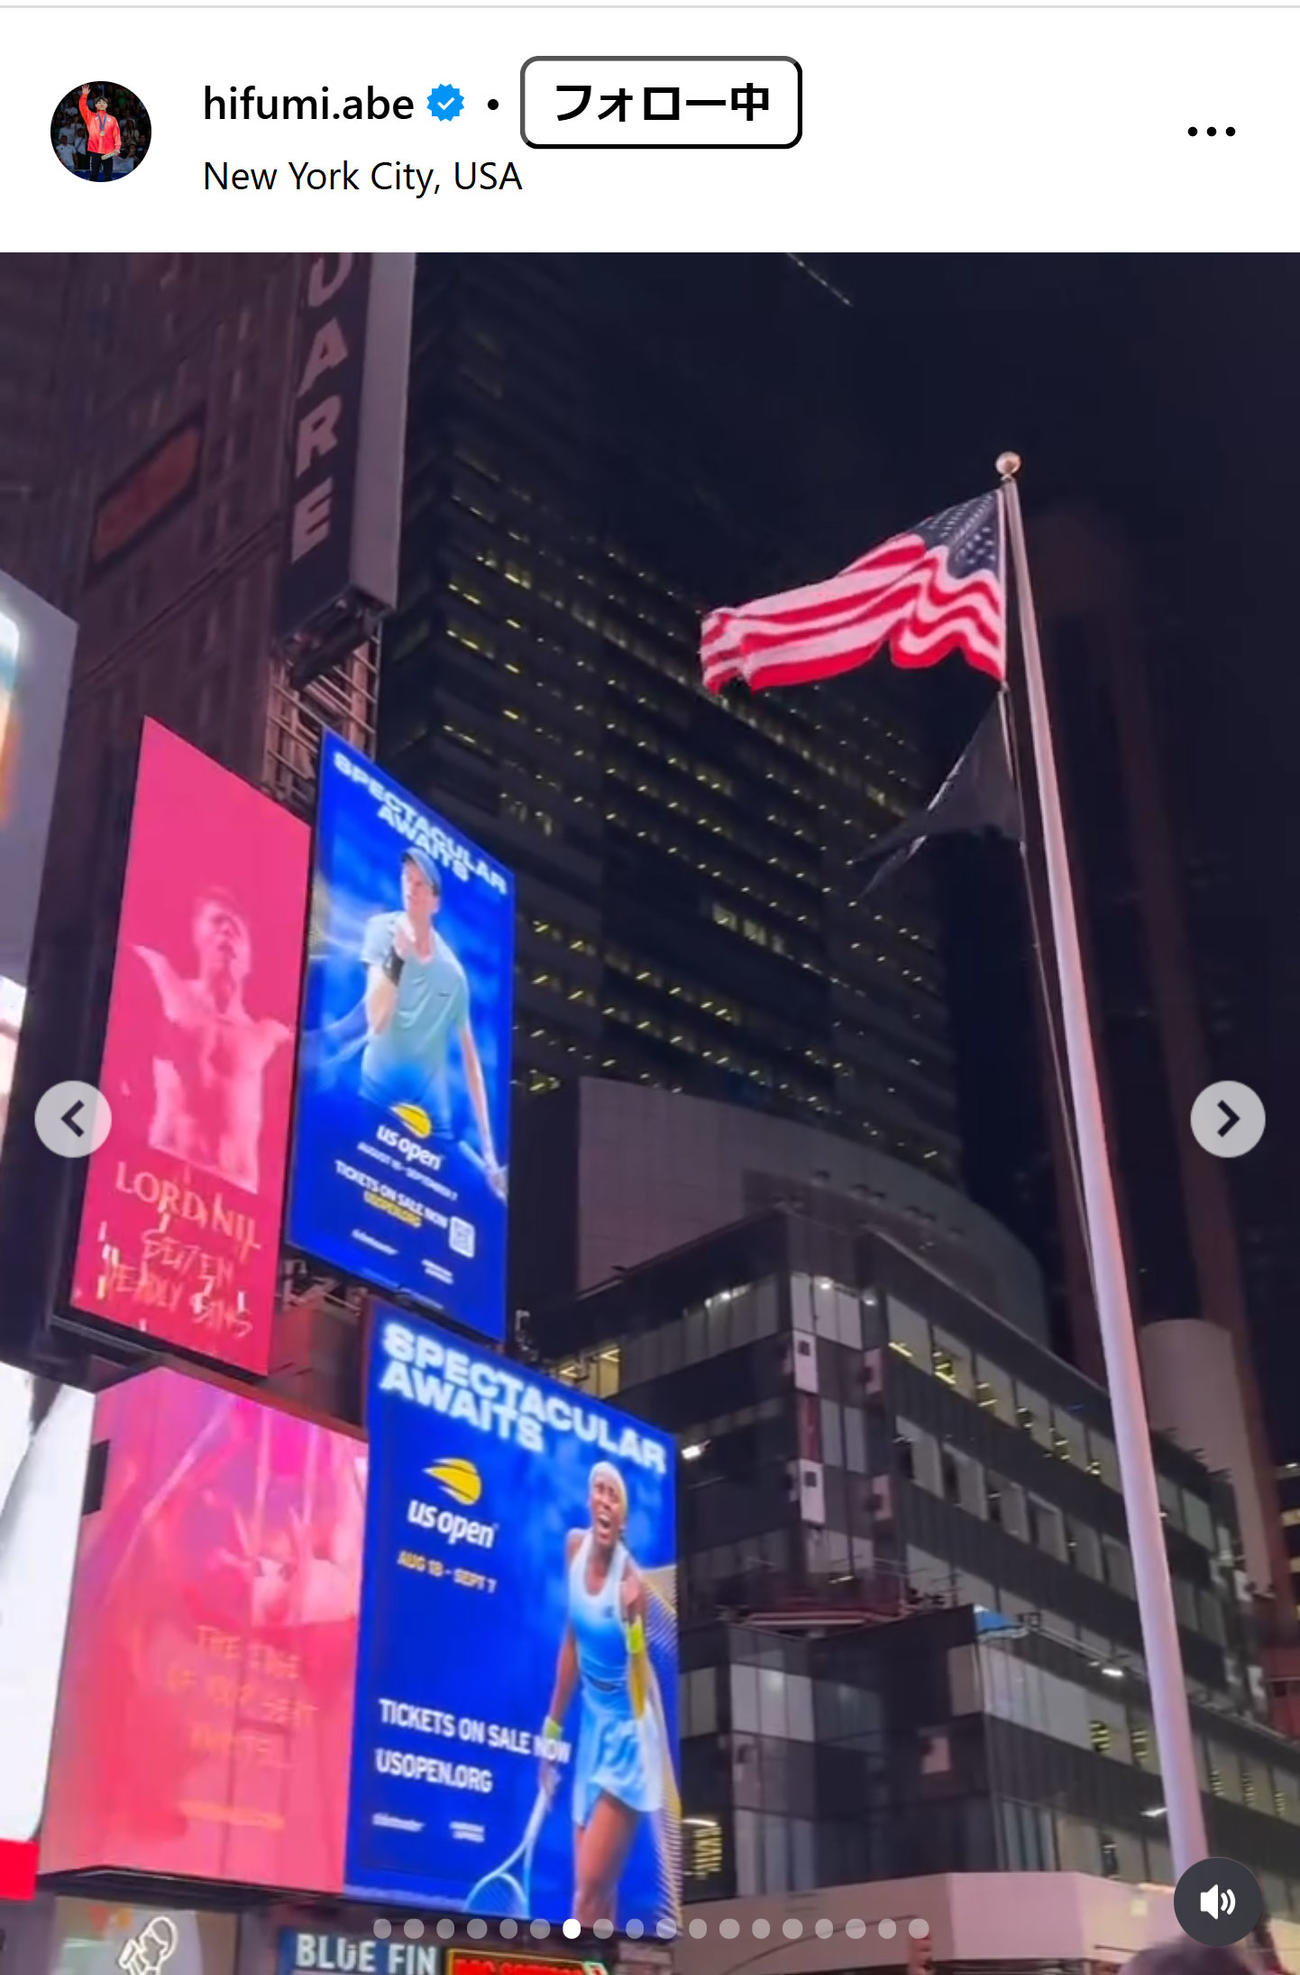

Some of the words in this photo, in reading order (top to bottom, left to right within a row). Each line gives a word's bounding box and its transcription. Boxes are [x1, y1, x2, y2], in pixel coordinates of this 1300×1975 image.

[333, 751, 508, 895] SPECTACULAR
[377, 804, 470, 882] AWAITS
[335, 1159, 379, 1192] TICKETS
[380, 1184, 397, 1201] ON
[397, 1192, 424, 1217] SALE
[379, 1359, 544, 1452] AWAITS
[382, 1322, 667, 1475] SPECTACULAR
[378, 1698, 456, 1737] TICKETS
[458, 1717, 485, 1744] ON
[487, 1724, 532, 1755] SALE
[532, 1735, 572, 1764] NOW
[375, 1748, 494, 1793] USOPEN.ORG
[387, 1942, 438, 1975] FIN
